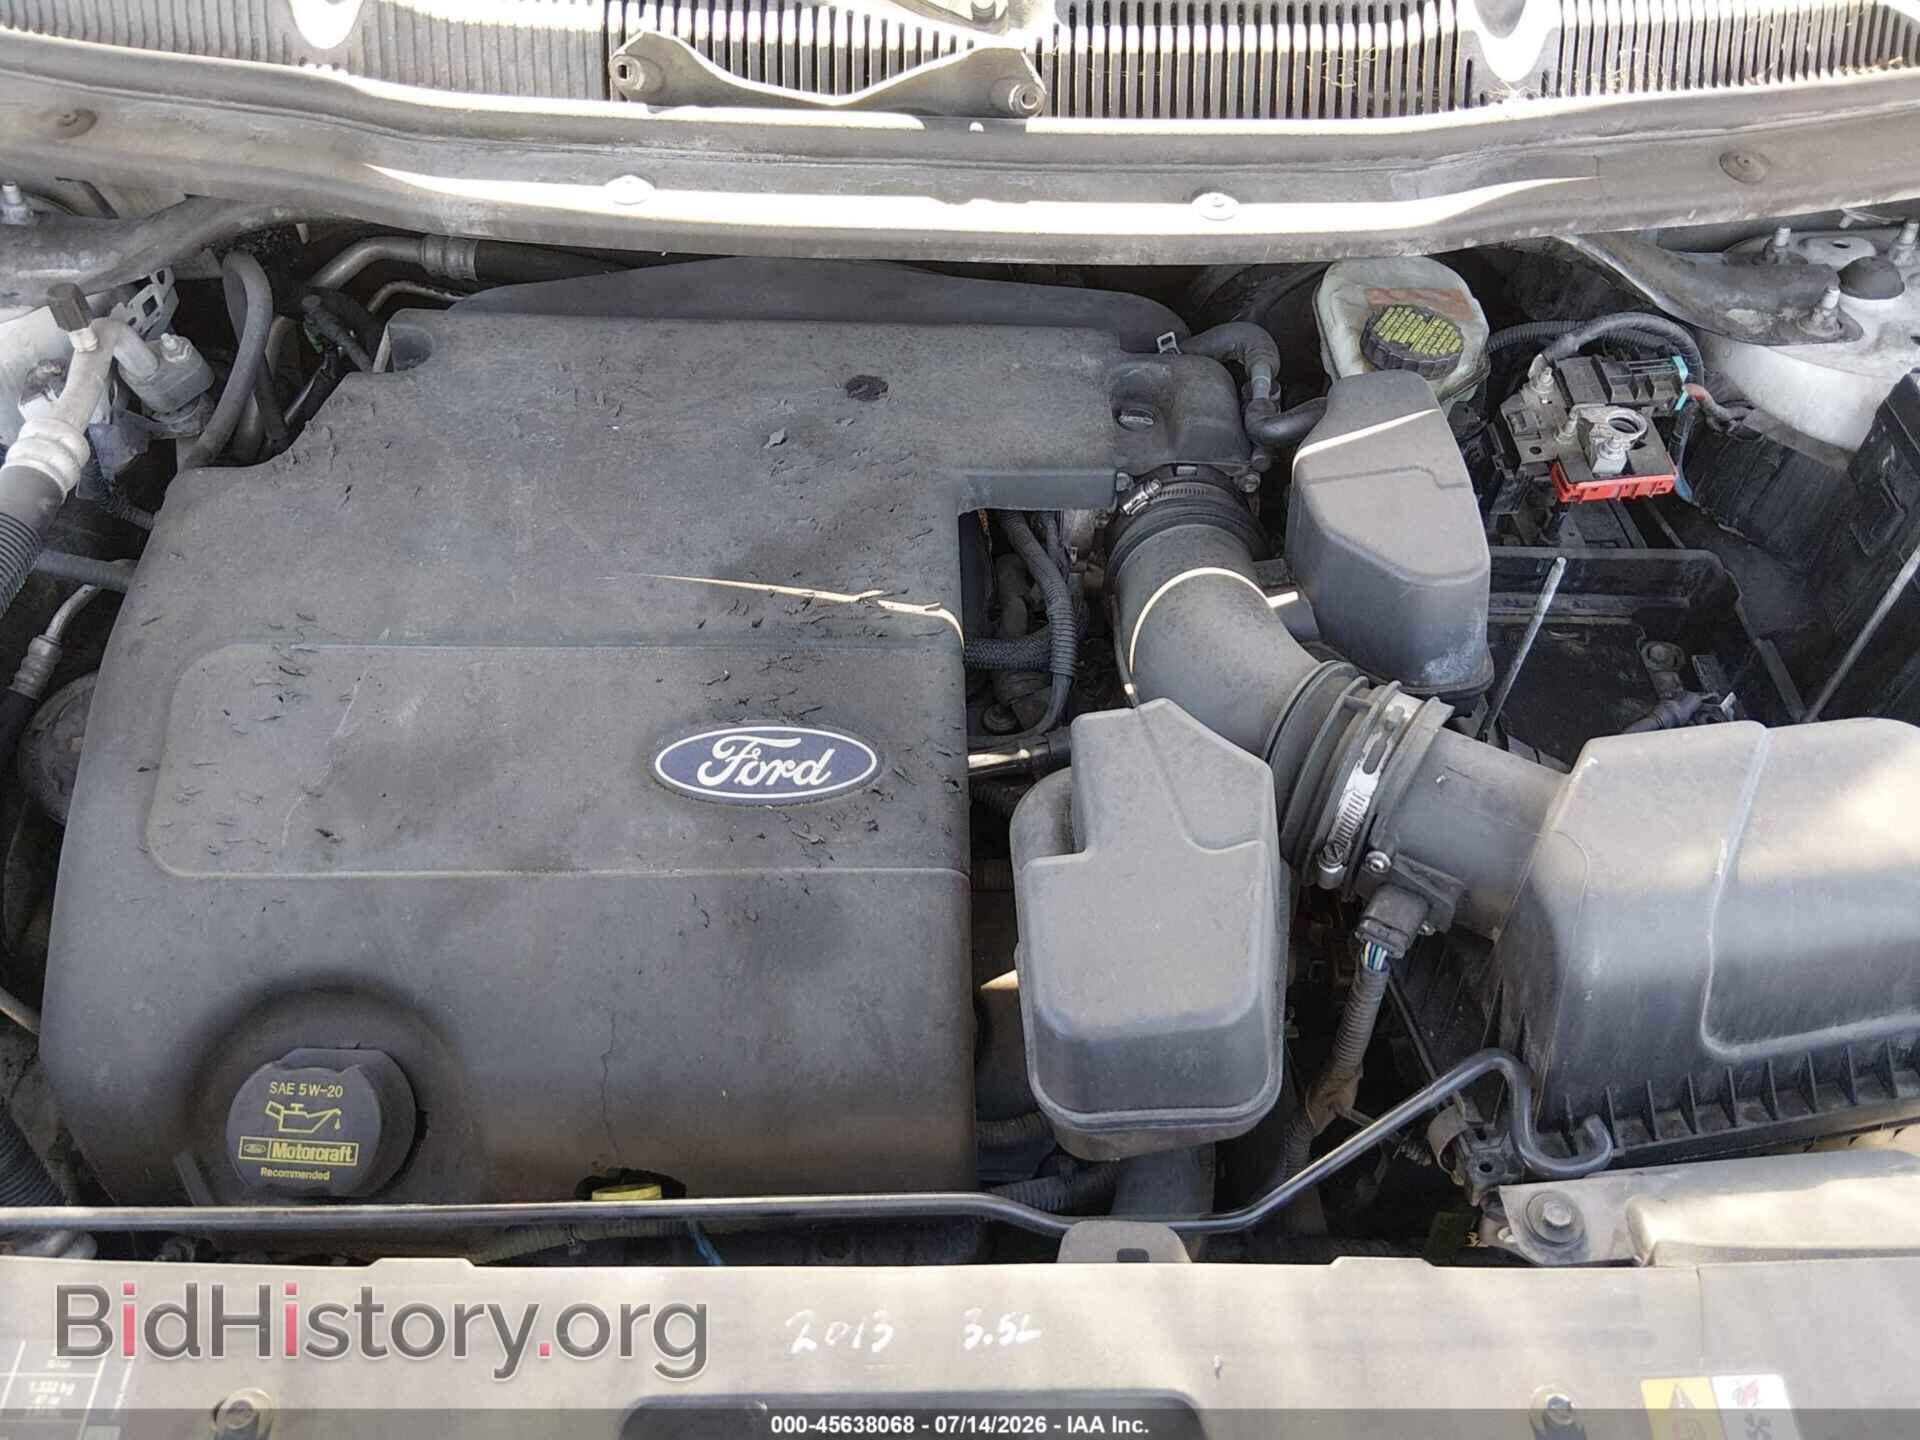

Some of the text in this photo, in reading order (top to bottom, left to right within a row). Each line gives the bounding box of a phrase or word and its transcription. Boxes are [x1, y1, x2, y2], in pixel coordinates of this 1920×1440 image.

[697, 735, 835, 786] Ford
[269, 1081, 344, 1098] SAE 5W-20
[271, 1142, 354, 1163] Motorcraft
[260, 1167, 330, 1181] Recommended
[785, 1303, 1042, 1354] 2013 3.5L
